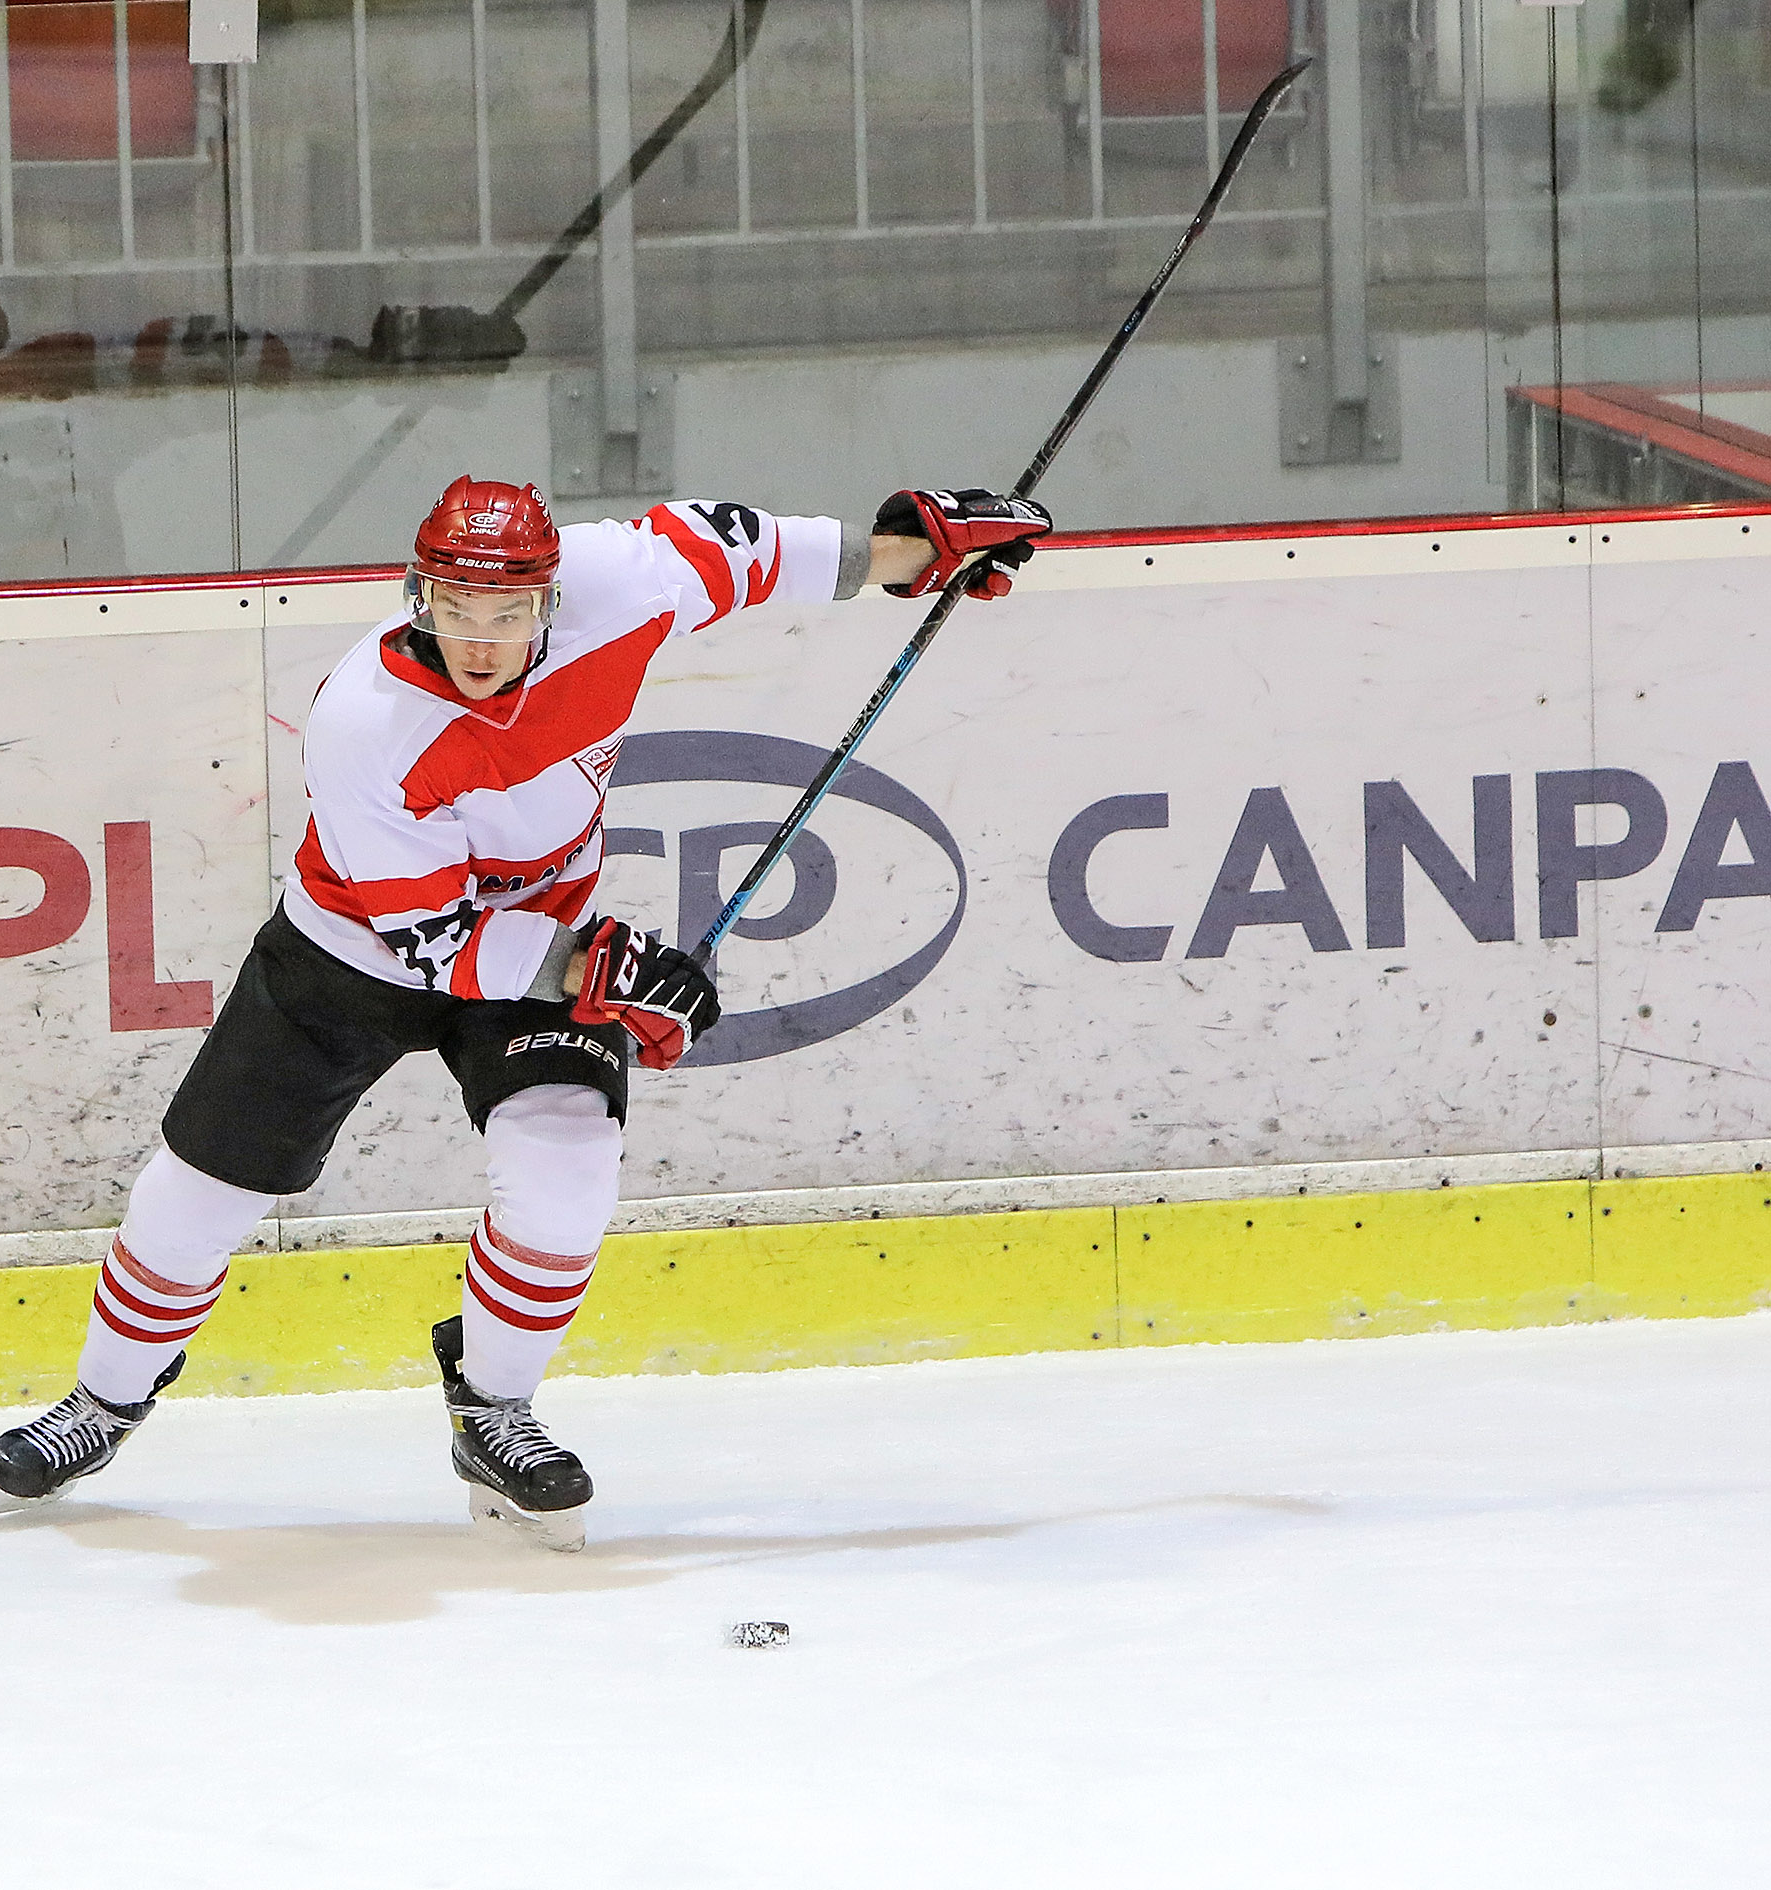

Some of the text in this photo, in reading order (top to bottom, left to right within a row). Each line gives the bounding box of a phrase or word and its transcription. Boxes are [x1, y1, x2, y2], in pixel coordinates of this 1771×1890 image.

[455, 557, 505, 570] BAUER
[836, 676, 894, 754] NEXUS
[1047, 761, 1771, 962] CANPA
[505, 1032, 620, 1071] BAUER
[472, 1455, 505, 1486] BAUER
